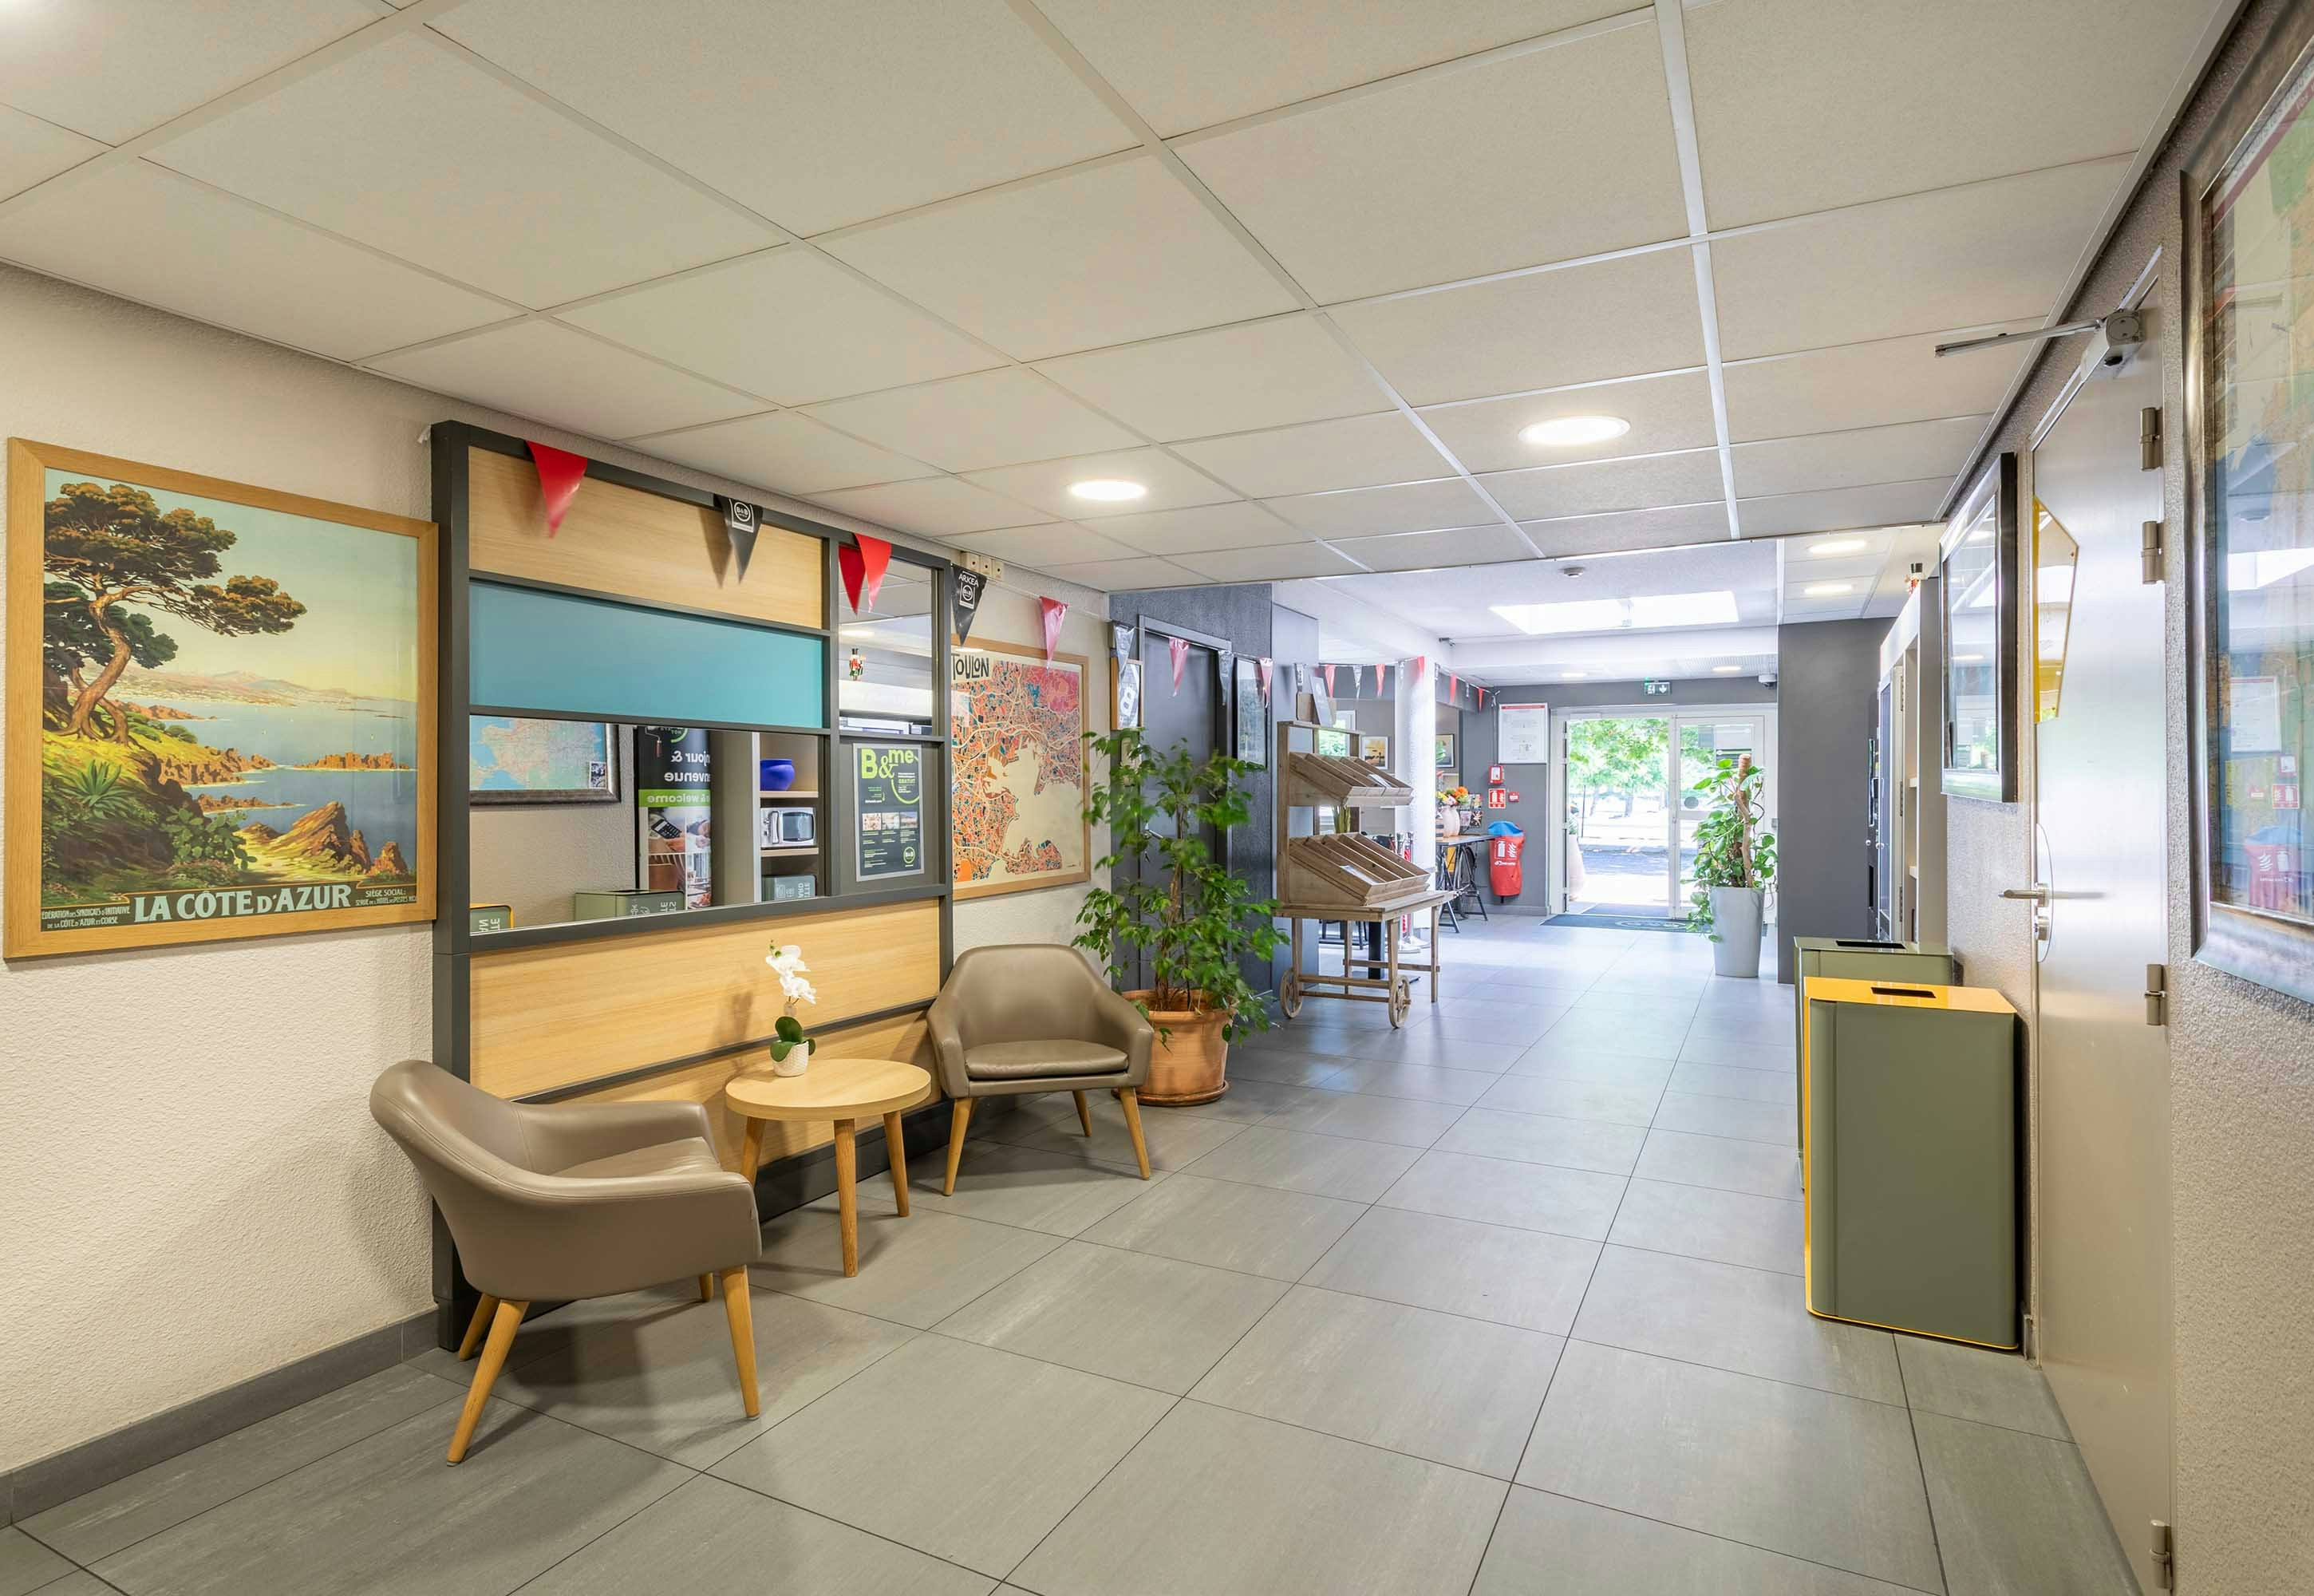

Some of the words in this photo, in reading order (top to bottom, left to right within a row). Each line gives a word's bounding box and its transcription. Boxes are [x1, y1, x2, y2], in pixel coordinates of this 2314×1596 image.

[958, 574, 979, 587] ARKEA
[950, 653, 989, 680] TOULON
[134, 895, 172, 922] LA
[176, 891, 254, 919] CÔTE
[256, 884, 352, 914] D'AZUR
